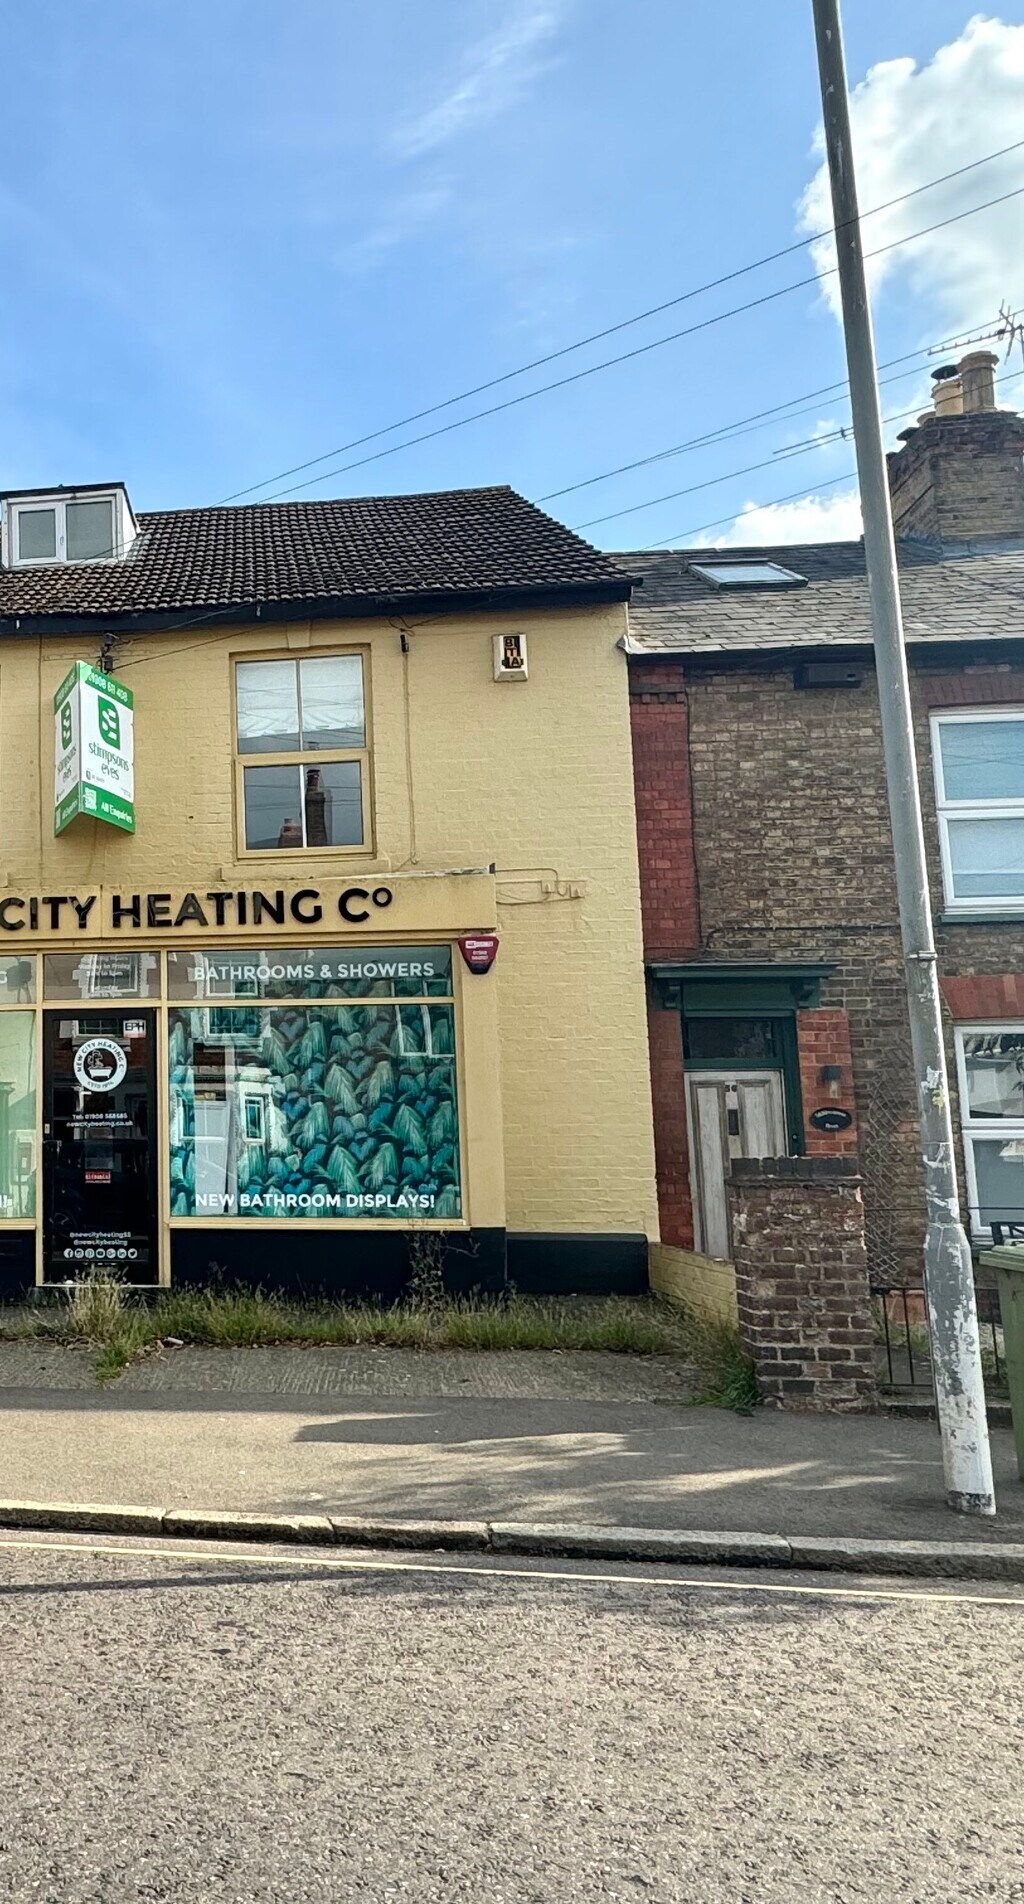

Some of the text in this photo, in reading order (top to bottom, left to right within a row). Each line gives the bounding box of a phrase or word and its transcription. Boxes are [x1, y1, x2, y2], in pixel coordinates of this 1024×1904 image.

[88, 742, 129, 771] stimpsons
[112, 889, 322, 928] HEATING
[194, 963, 435, 980] BATHROOMS & SHOWERS
[125, 1021, 144, 1032] EPH
[82, 1042, 96, 1054] CITY
[97, 1041, 124, 1063] HEATING
[195, 1193, 435, 1209] NEW BATHROOM DISPLAYS!
